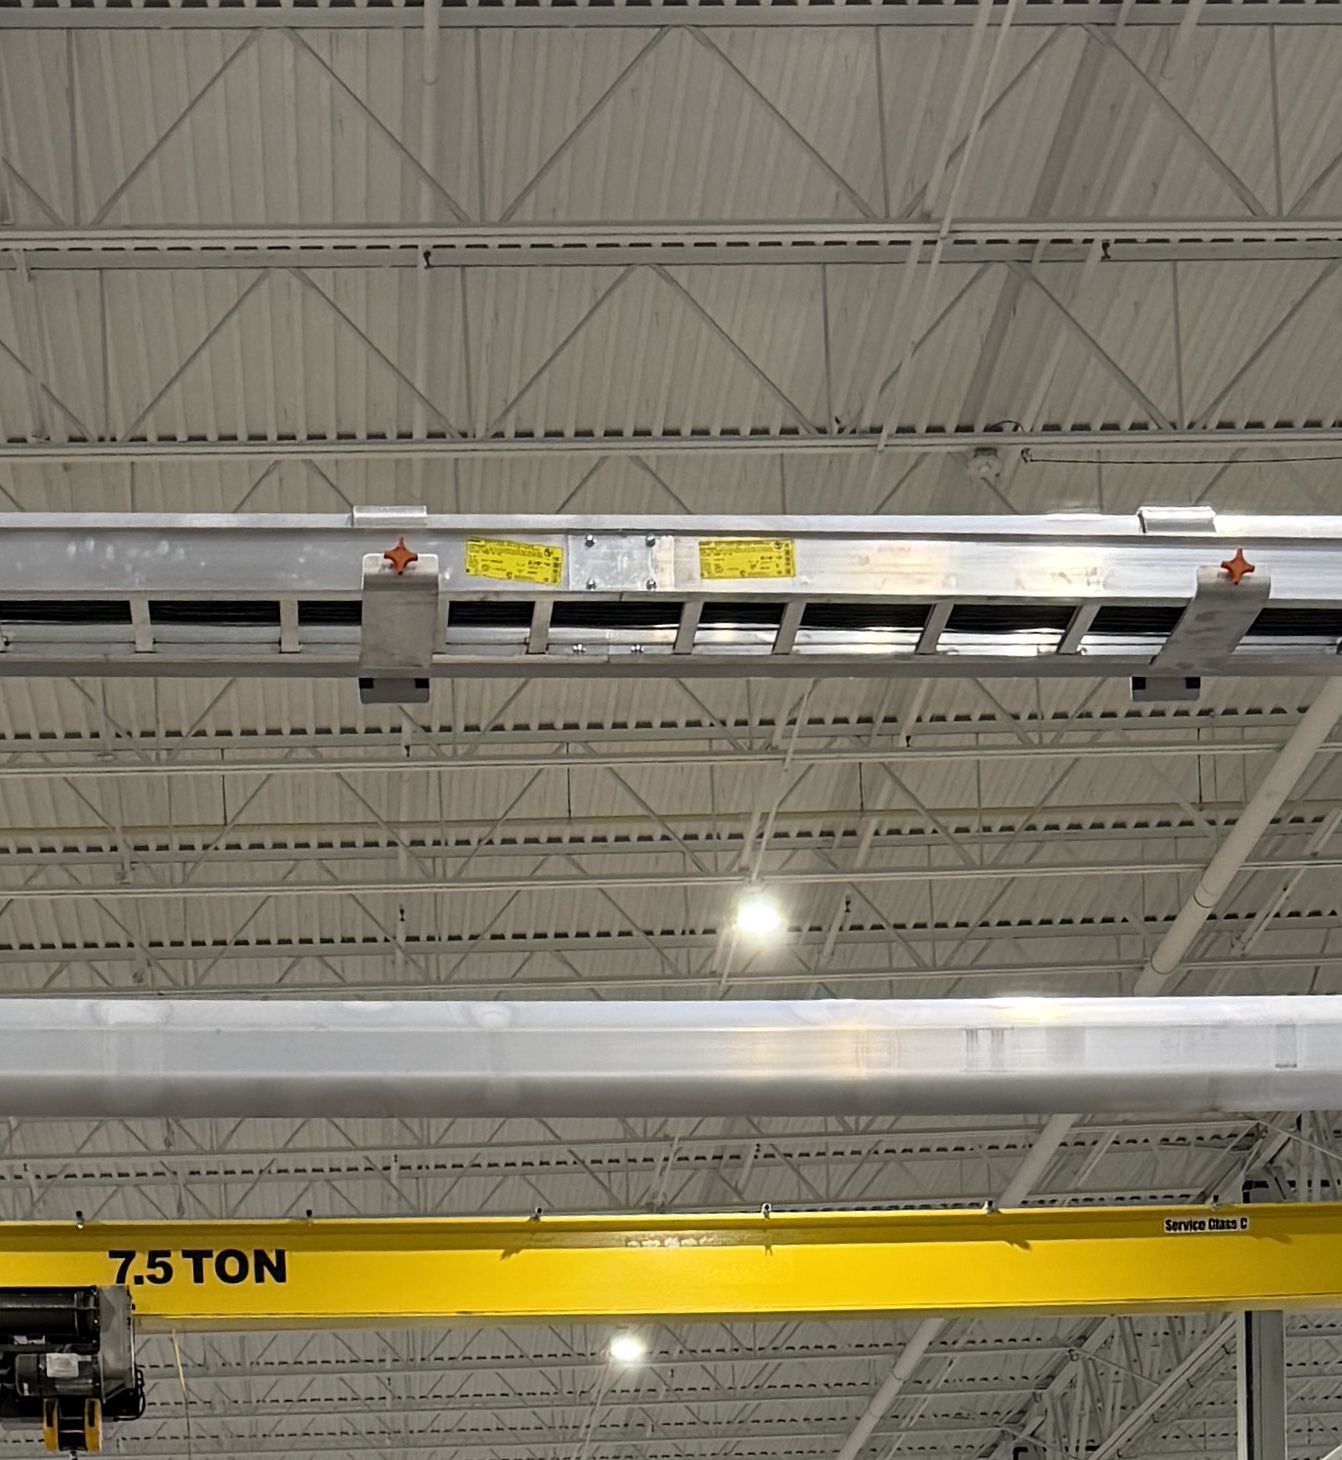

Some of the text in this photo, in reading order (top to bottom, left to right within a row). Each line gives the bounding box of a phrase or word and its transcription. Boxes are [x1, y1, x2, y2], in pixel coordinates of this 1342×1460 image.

[1165, 1219, 1206, 1232] Service
[1240, 1217, 1248, 1229] C
[108, 1248, 287, 1285] 7.5 TON
